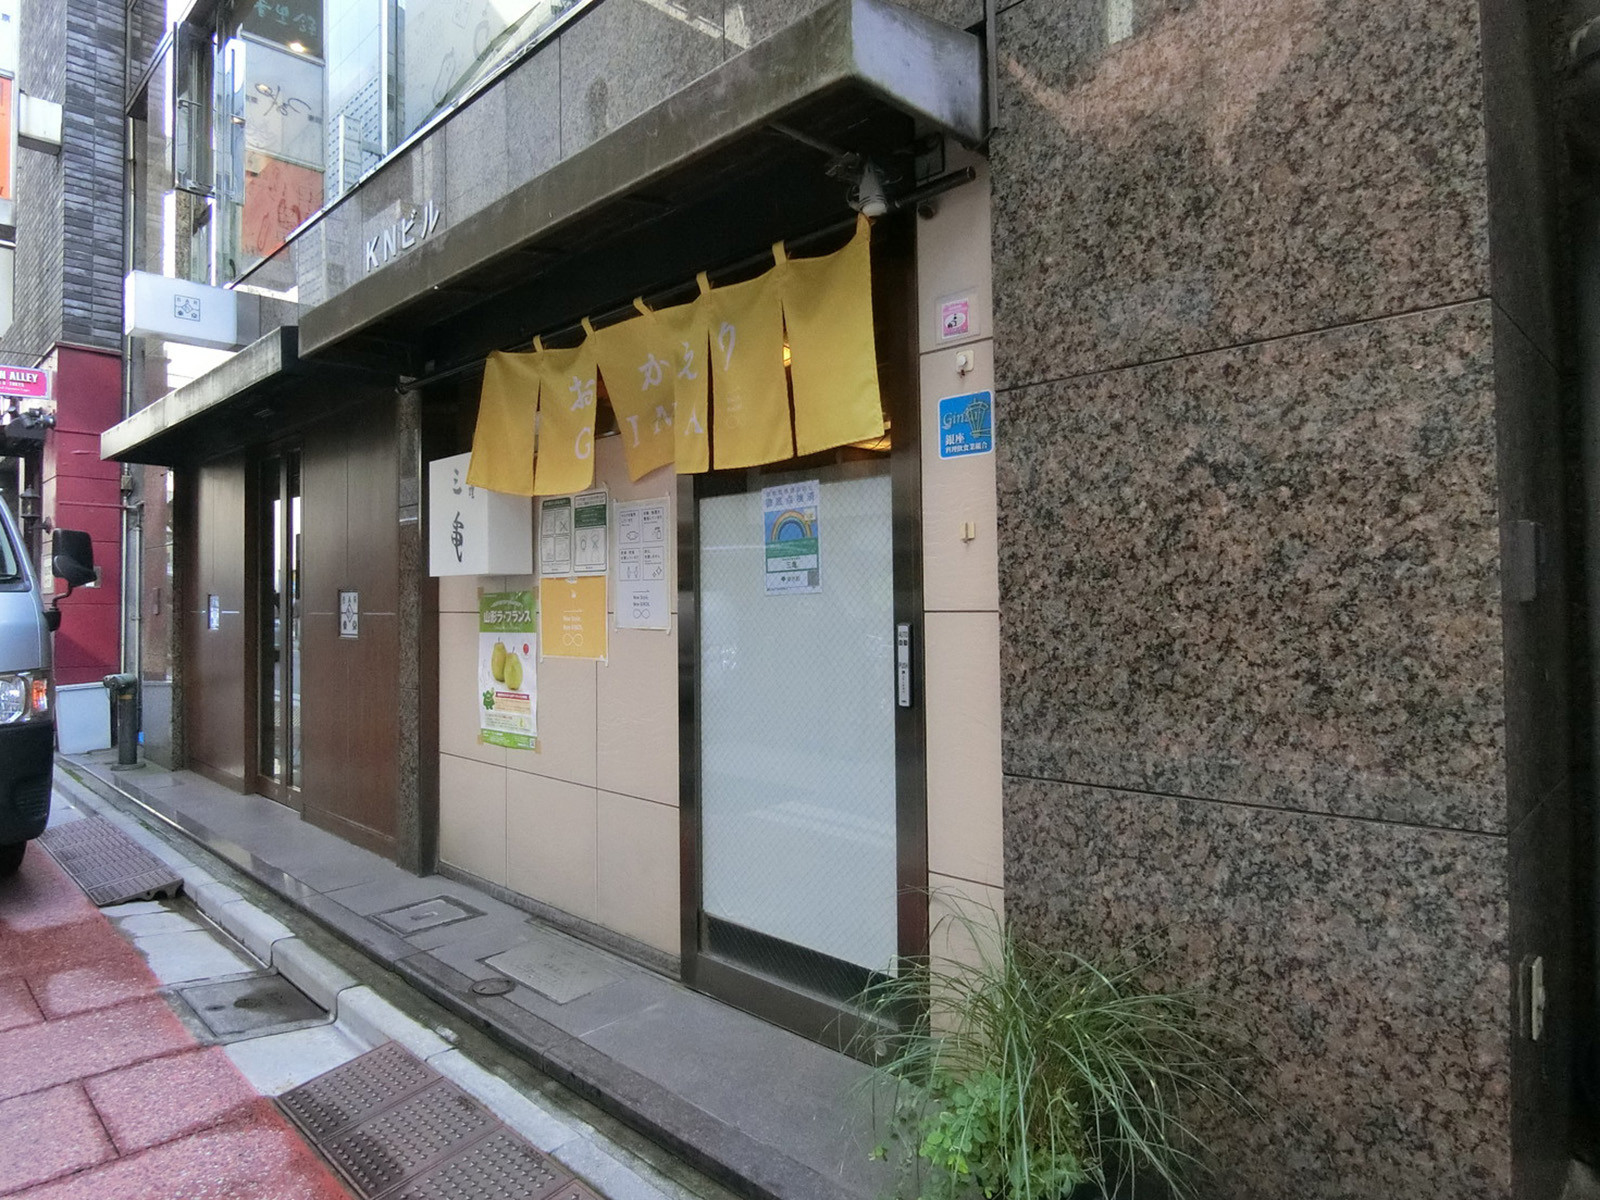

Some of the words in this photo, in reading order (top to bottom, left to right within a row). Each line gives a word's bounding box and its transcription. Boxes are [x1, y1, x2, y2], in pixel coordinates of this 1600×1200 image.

[366, 199, 440, 273] KNビル
[9, 371, 38, 383] ALLEY
[569, 321, 736, 412] おかえり
